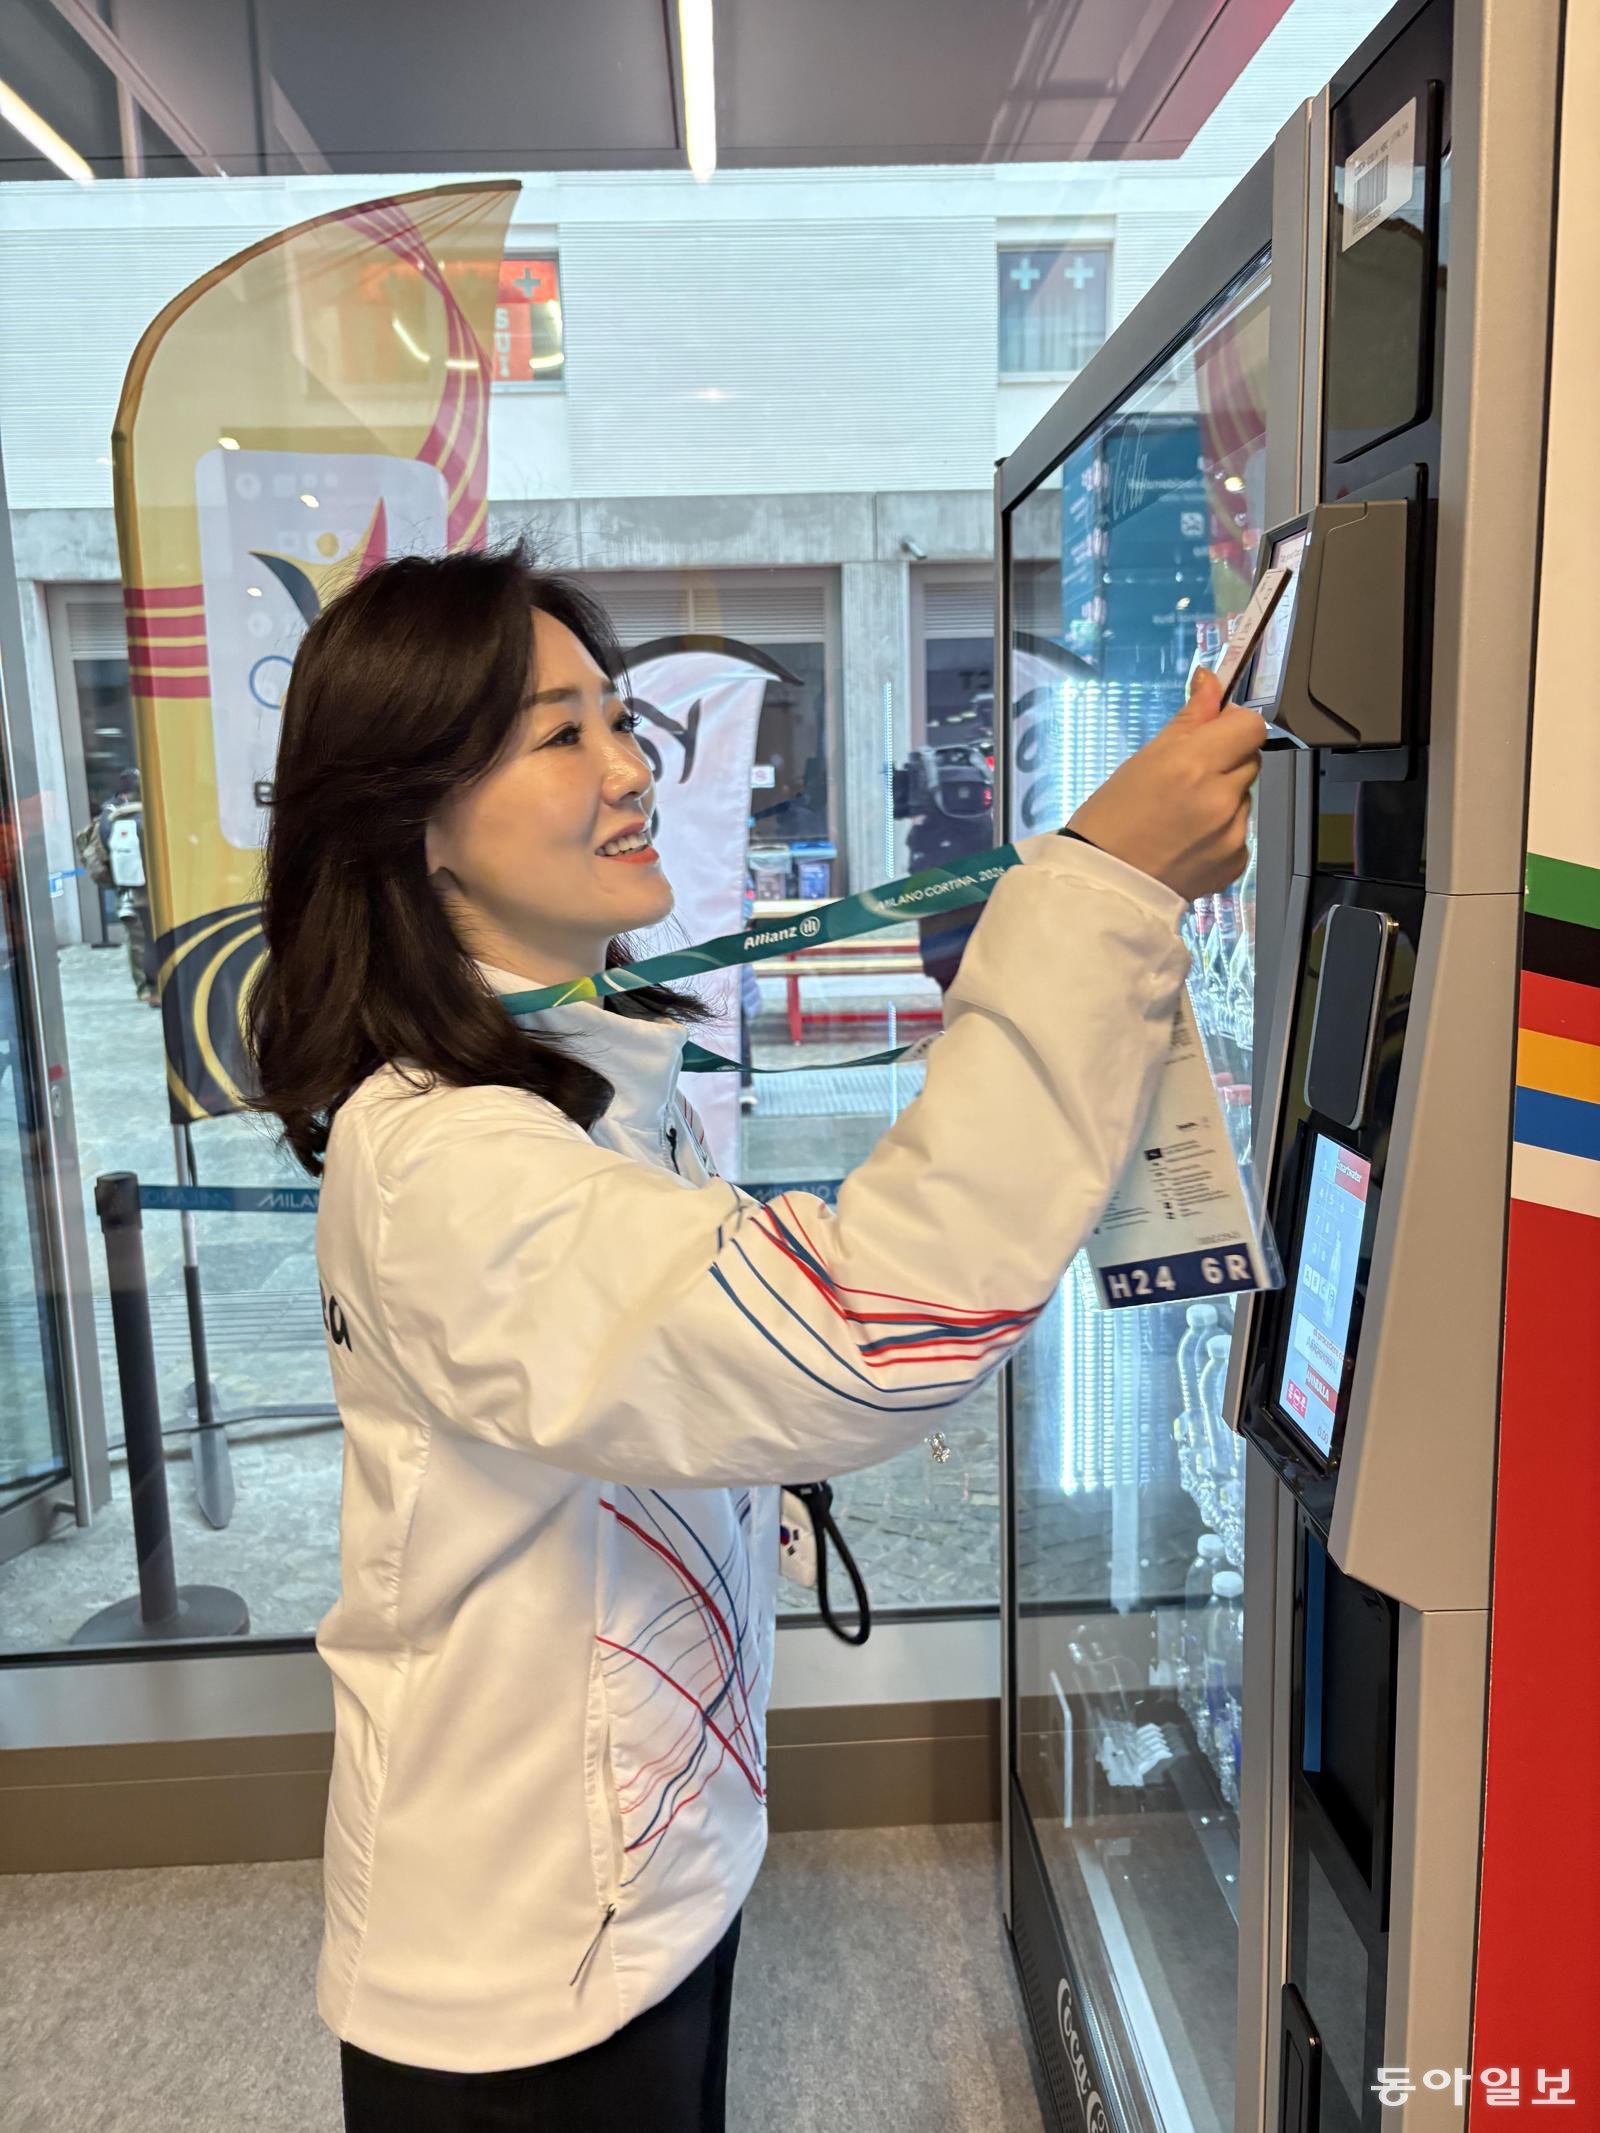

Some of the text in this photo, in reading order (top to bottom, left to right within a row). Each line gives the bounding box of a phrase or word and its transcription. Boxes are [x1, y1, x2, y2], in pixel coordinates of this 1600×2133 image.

[744, 925, 798, 950] Allianz
[877, 890, 924, 912] MILANO
[924, 875, 978, 899] CORTINA
[257, 1192, 318, 1209] MILA
[1107, 1253, 1252, 1301] H24 6R
